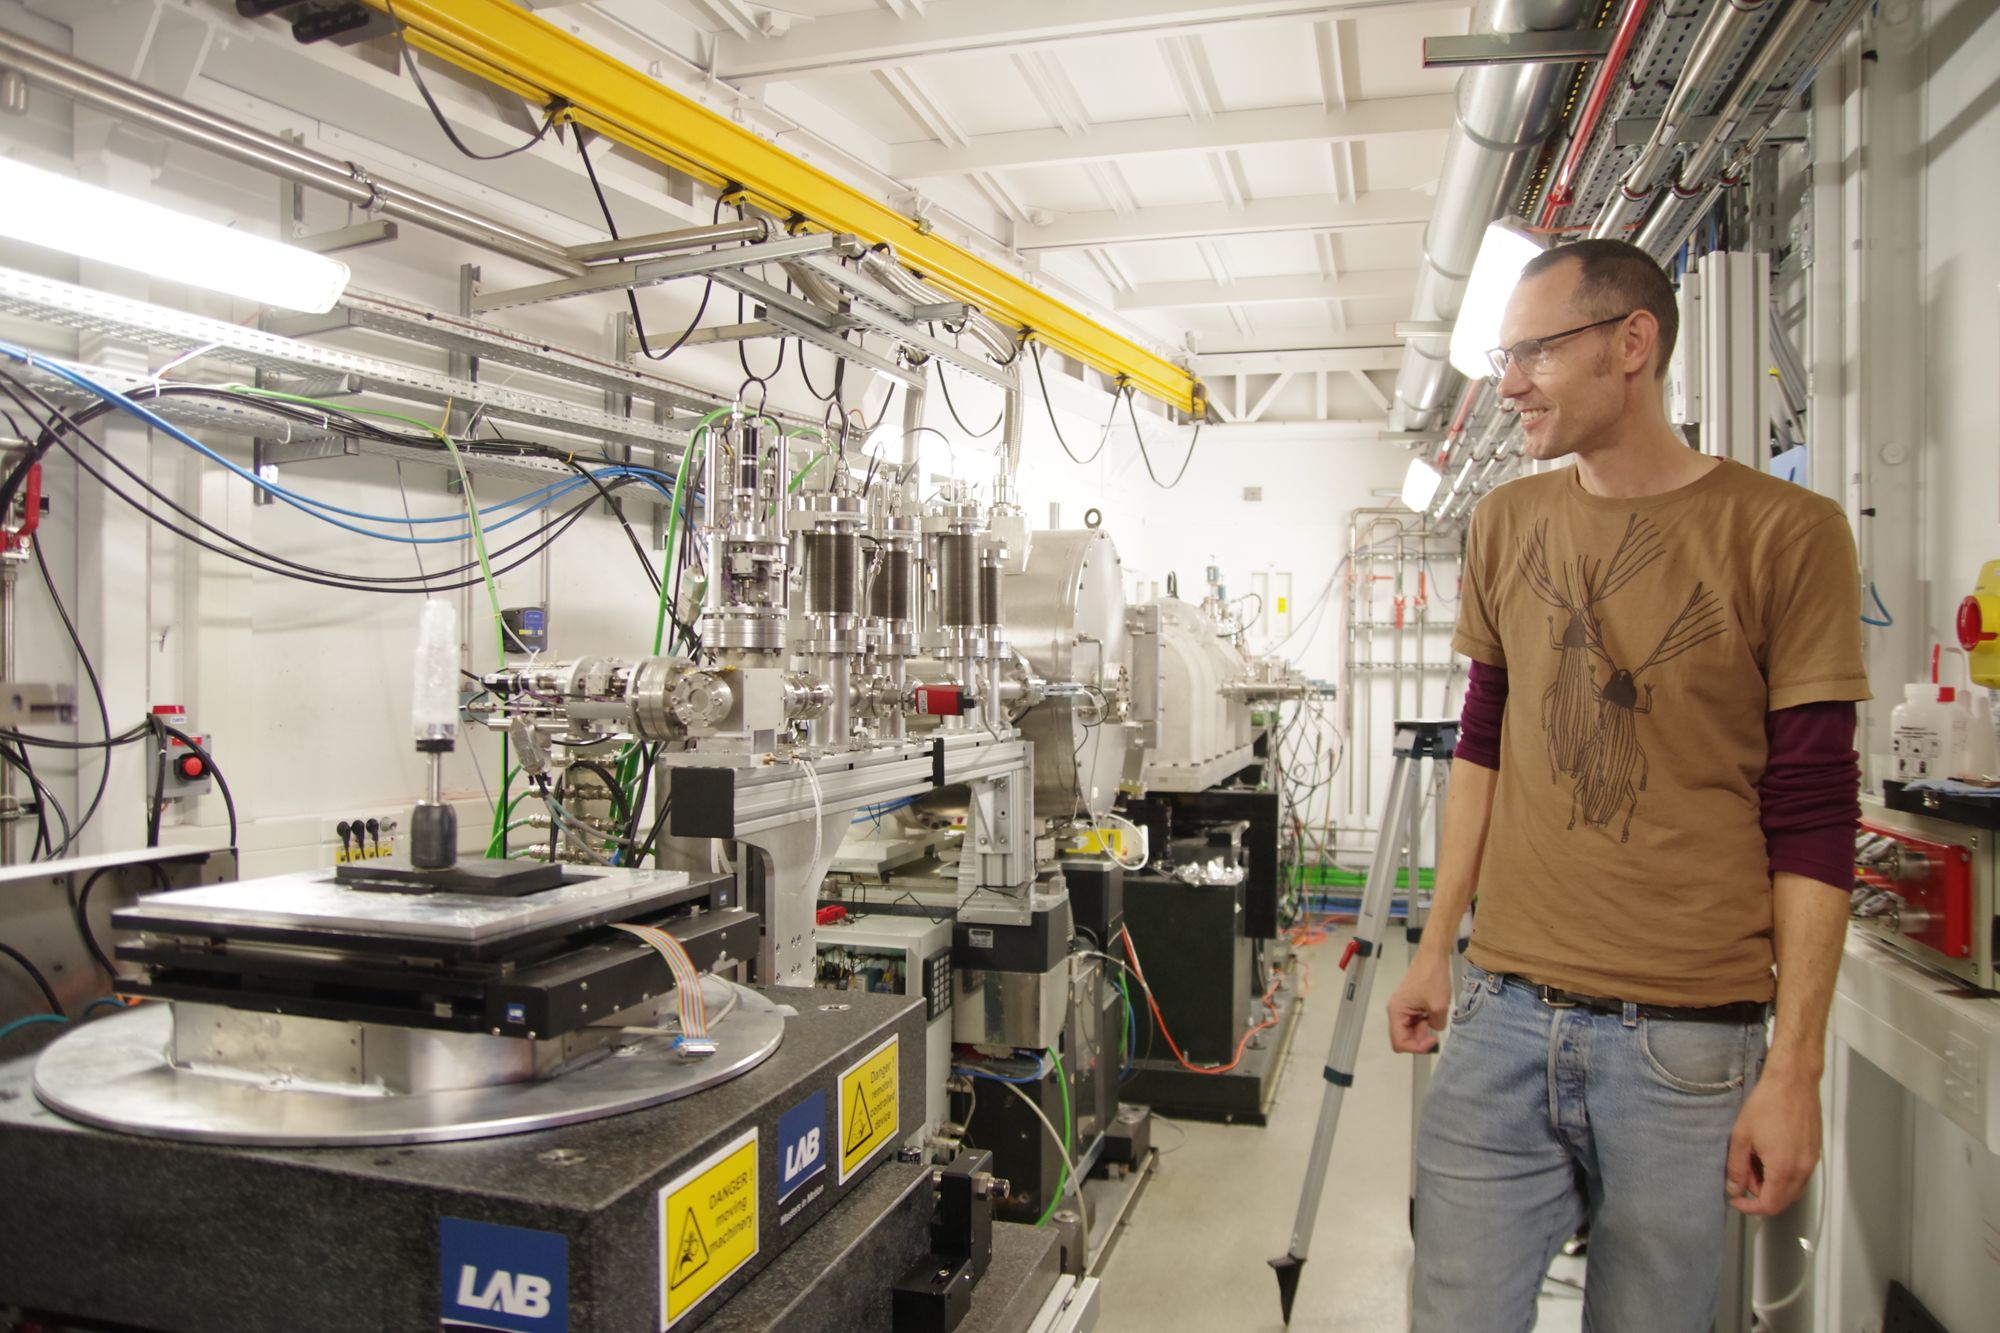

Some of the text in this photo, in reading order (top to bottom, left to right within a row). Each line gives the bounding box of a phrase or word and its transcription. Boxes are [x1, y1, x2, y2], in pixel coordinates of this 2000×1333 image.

[871, 1061, 891, 1084] Danger
[870, 1090, 896, 1118] controlled
[872, 1077, 894, 1100] remotely
[875, 1111, 891, 1130] device
[784, 1126, 820, 1182] LAB
[709, 1171, 748, 1211] DANGER
[716, 1196, 747, 1227] moving
[709, 1213, 753, 1254] machinery
[456, 1264, 551, 1319] LAB
